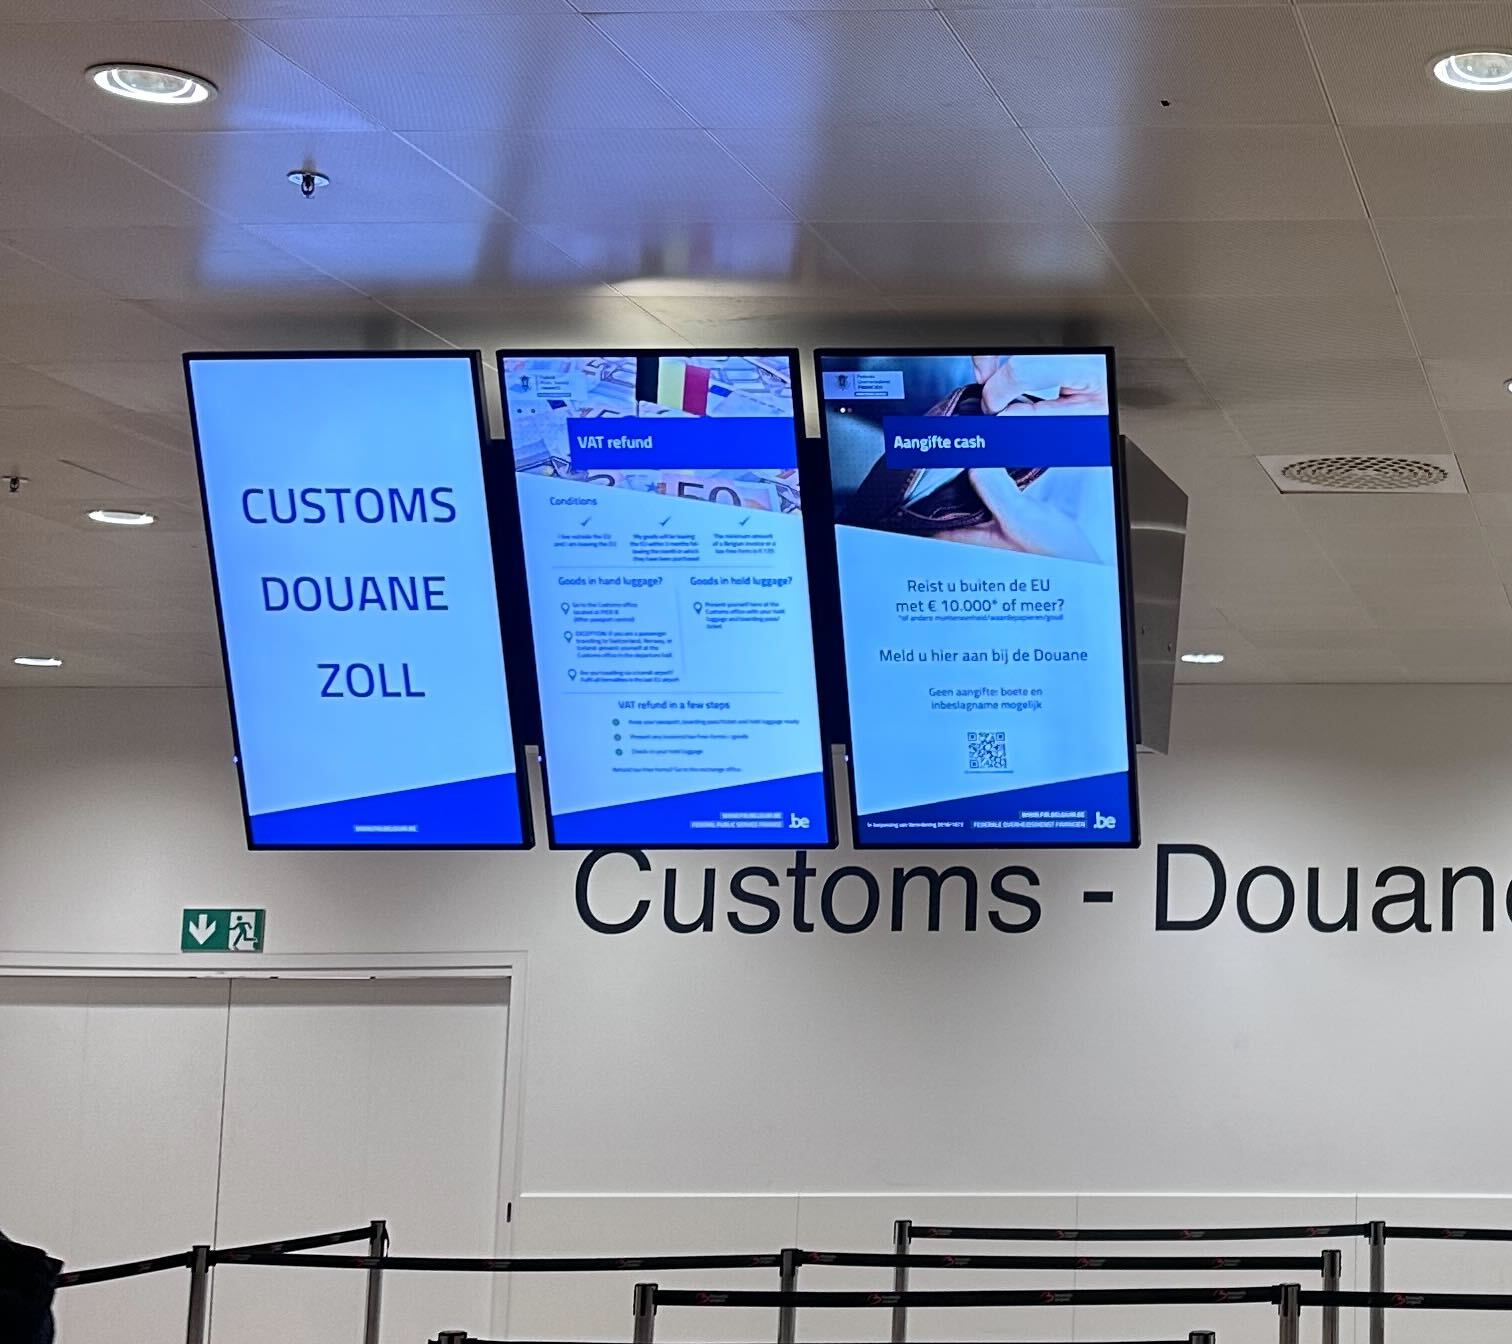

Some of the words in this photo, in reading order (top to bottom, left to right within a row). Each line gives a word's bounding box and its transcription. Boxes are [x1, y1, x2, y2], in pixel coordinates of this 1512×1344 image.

[577, 436, 604, 448] VAT
[608, 436, 652, 448] refund
[894, 435, 951, 452] Aangifte
[954, 435, 985, 448] cash
[242, 487, 455, 524] CUSTOMS
[550, 497, 597, 505] Conditions
[558, 577, 586, 585] Goods
[598, 577, 621, 585] hand
[623, 577, 663, 587] luggage?
[690, 577, 719, 585] Goods
[753, 577, 792, 587] luggage?
[908, 580, 943, 592] Reist
[948, 583, 955, 592] u
[960, 580, 1005, 592] buiten
[1010, 579, 1026, 591] de
[1031, 579, 1049, 591] EU
[261, 576, 448, 611] DOUANE
[896, 601, 924, 612] met
[928, 600, 936, 612] €
[1002, 599, 1016, 611] of
[1021, 599, 1064, 611] meer?
[880, 649, 914, 662] Meld
[919, 653, 927, 661] u
[931, 649, 958, 661] hier
[963, 653, 987, 661] aan
[992, 649, 1008, 664] bij
[1013, 649, 1029, 661] de
[1034, 649, 1087, 661] Douane
[317, 663, 425, 697] ZOLL
[929, 688, 953, 696] Geen
[1001, 688, 1028, 696] boete
[638, 701, 667, 709] refund
[687, 701, 704, 709] few
[705, 702, 730, 710] steps
[932, 701, 998, 711] inbeslagname
[1001, 701, 1042, 711] mogelijk
[575, 847, 1042, 934] Customs
[1082, 890, 1114, 904] -
